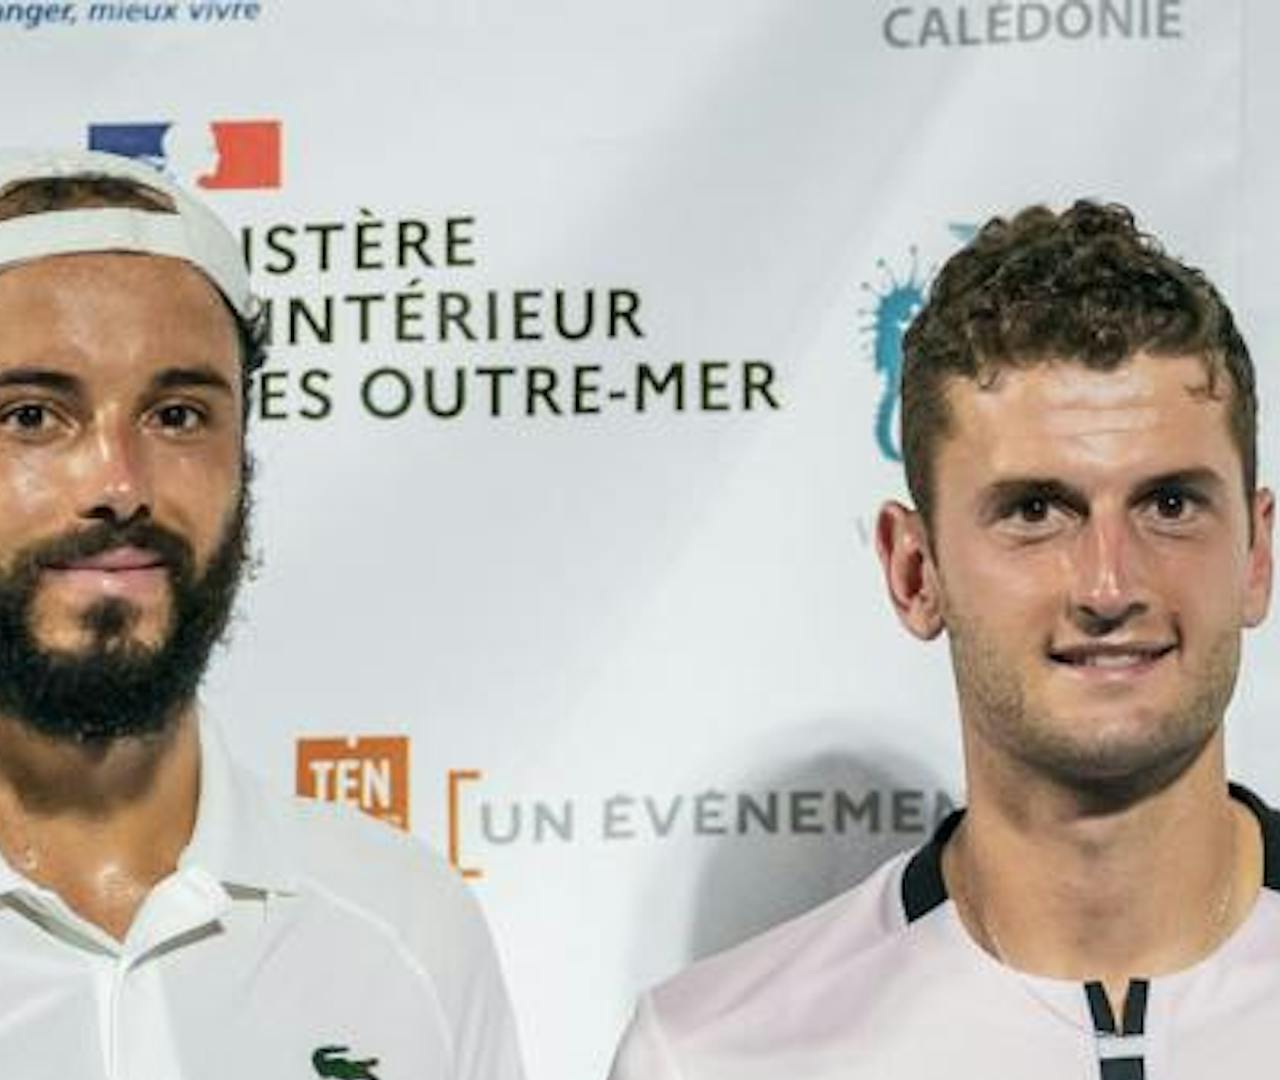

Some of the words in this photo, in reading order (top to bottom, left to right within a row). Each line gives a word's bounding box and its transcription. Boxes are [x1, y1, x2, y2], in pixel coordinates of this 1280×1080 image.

[88, 0, 178, 22] mieux
[188, 0, 262, 21] vivre
[360, 361, 782, 419] OUTRE-MER
[309, 759, 391, 809] TEN
[480, 802, 574, 844] UN
